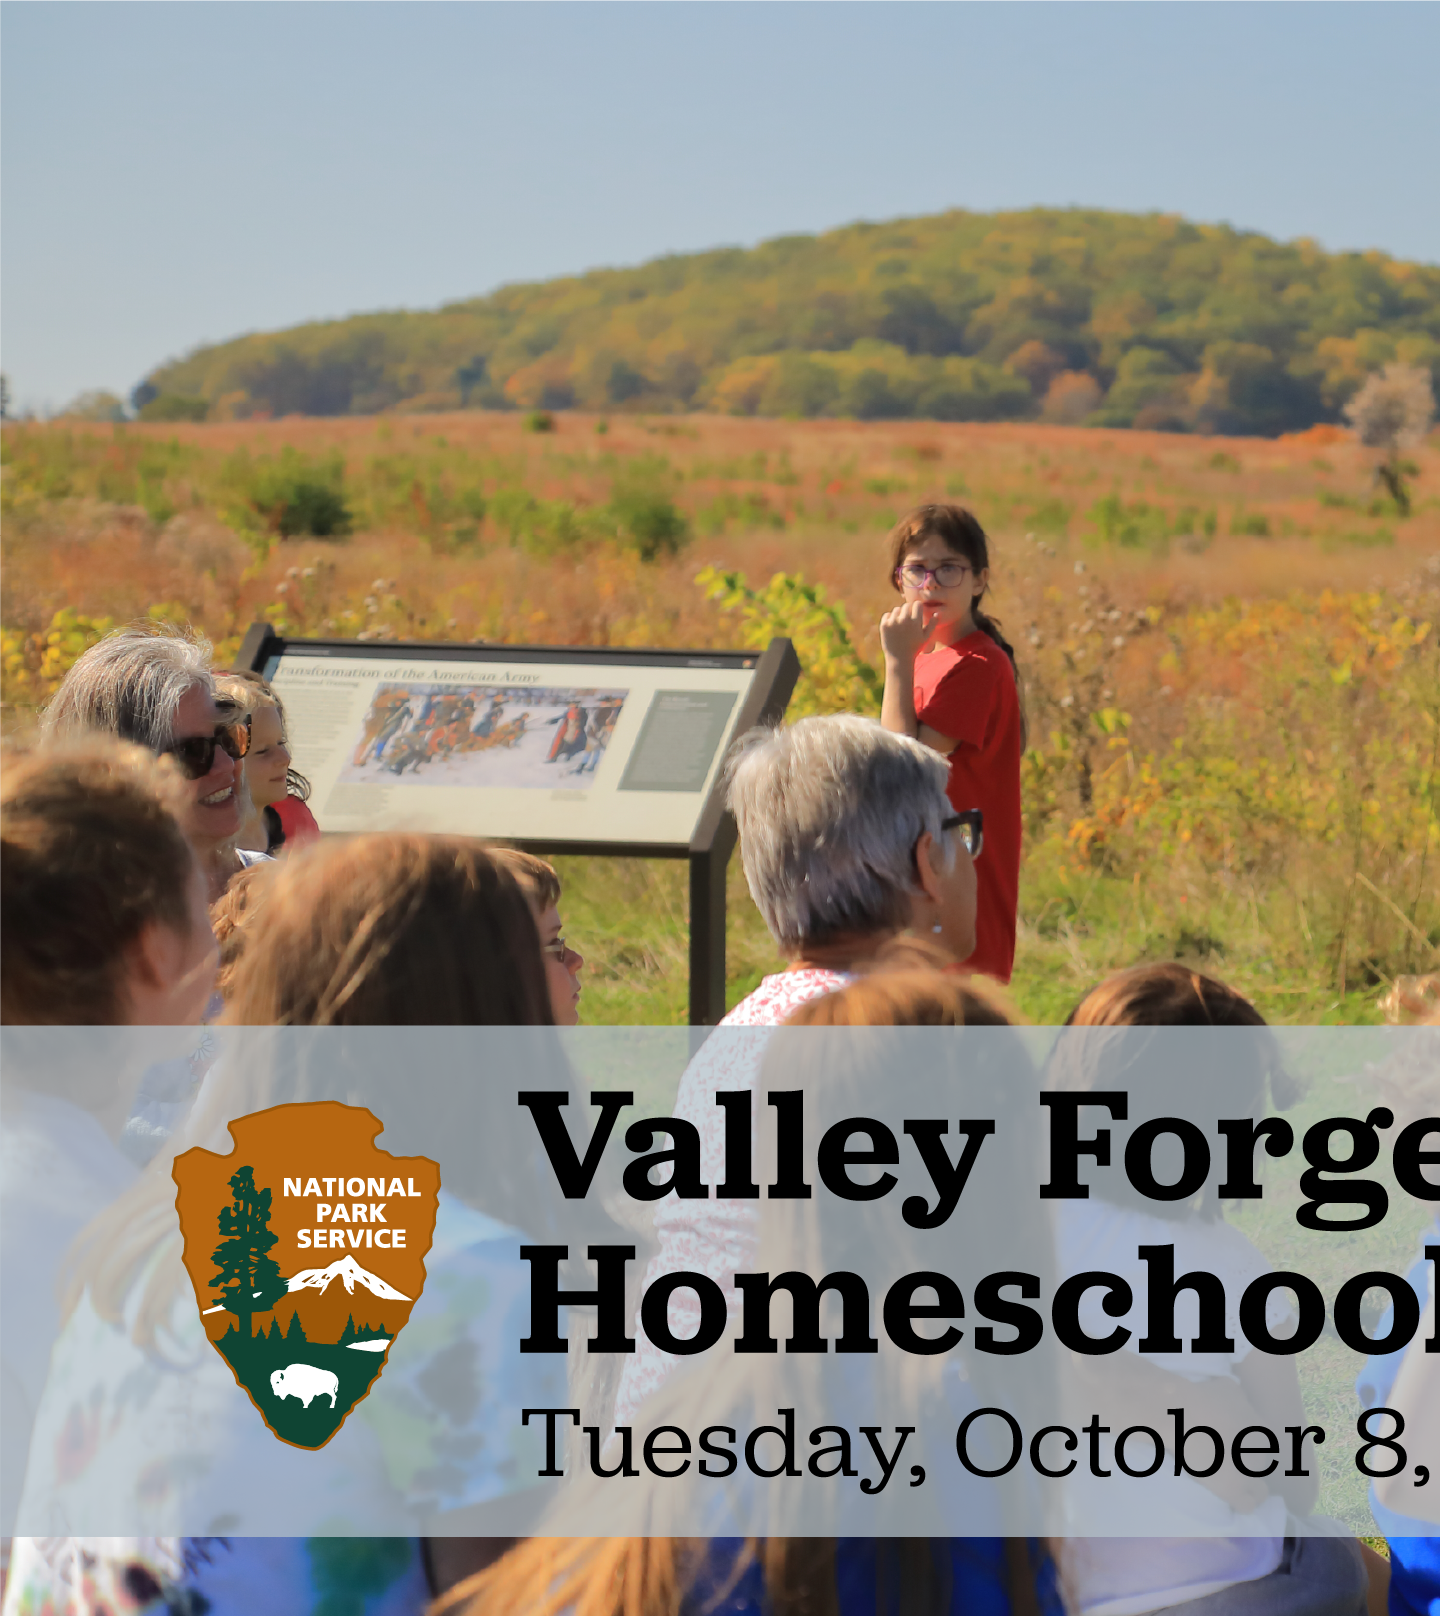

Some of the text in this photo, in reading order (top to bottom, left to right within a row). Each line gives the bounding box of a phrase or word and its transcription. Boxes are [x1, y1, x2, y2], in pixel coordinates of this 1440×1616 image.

[384, 667, 401, 678] of
[402, 668, 425, 679] the
[428, 669, 496, 681] American
[499, 671, 540, 683] Army
